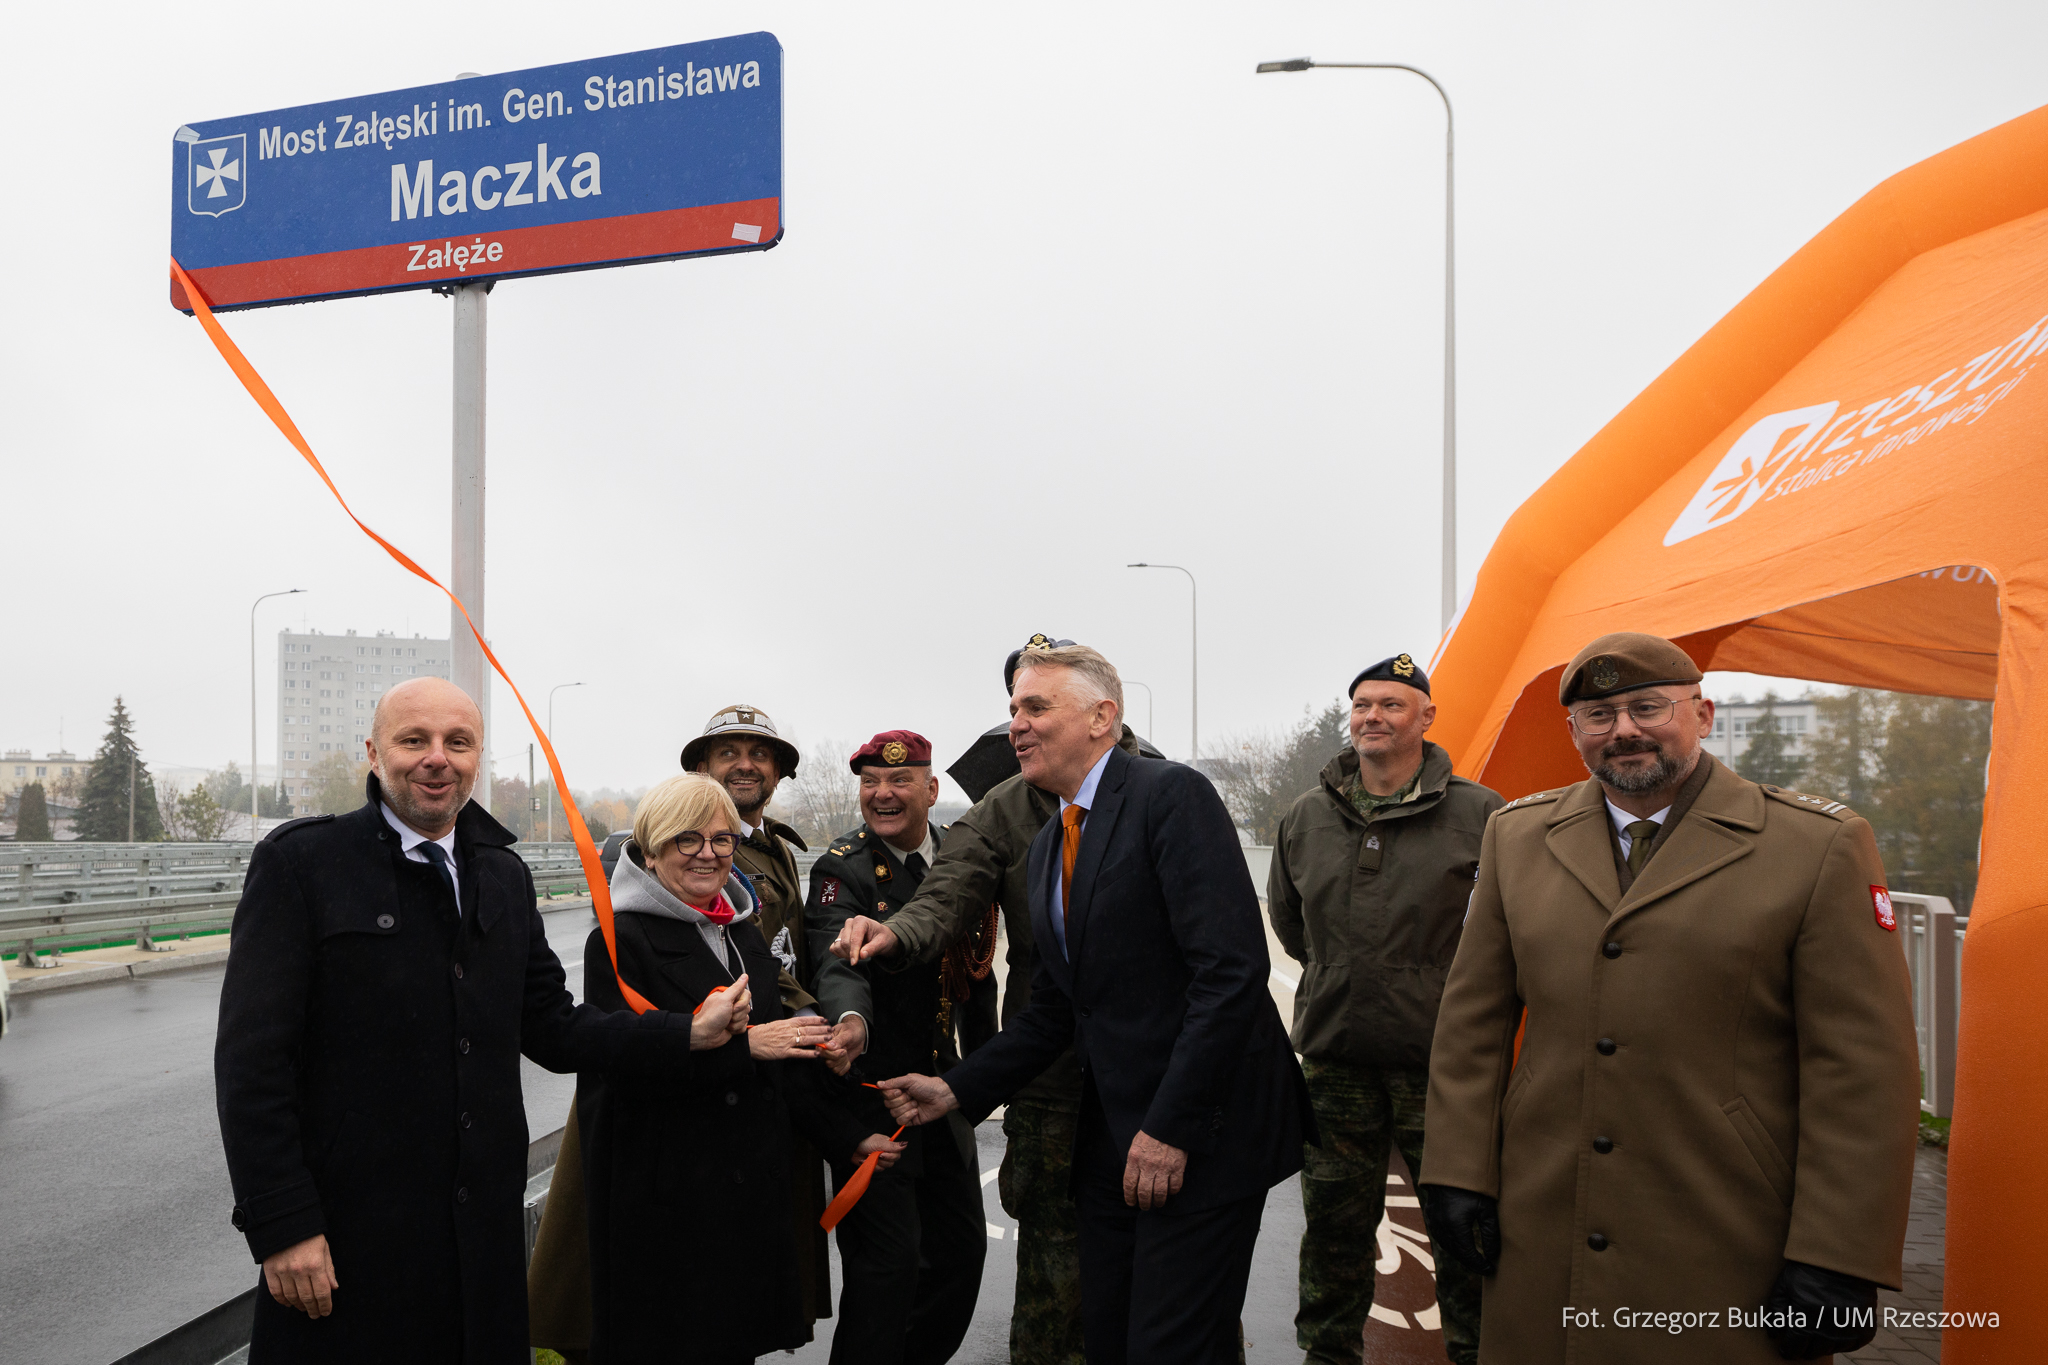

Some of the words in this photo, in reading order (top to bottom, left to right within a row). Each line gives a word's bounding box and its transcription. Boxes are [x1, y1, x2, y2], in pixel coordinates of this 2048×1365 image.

[259, 120, 327, 161] Most
[334, 101, 438, 151] Załęski
[448, 98, 491, 133] im.
[502, 87, 573, 124] Gen.
[583, 60, 761, 112] Stanisława
[390, 142, 602, 222] Maczka
[406, 237, 504, 273] Załęże
[1765, 448, 1864, 502] stolica
[1858, 361, 2038, 467] innowacji
